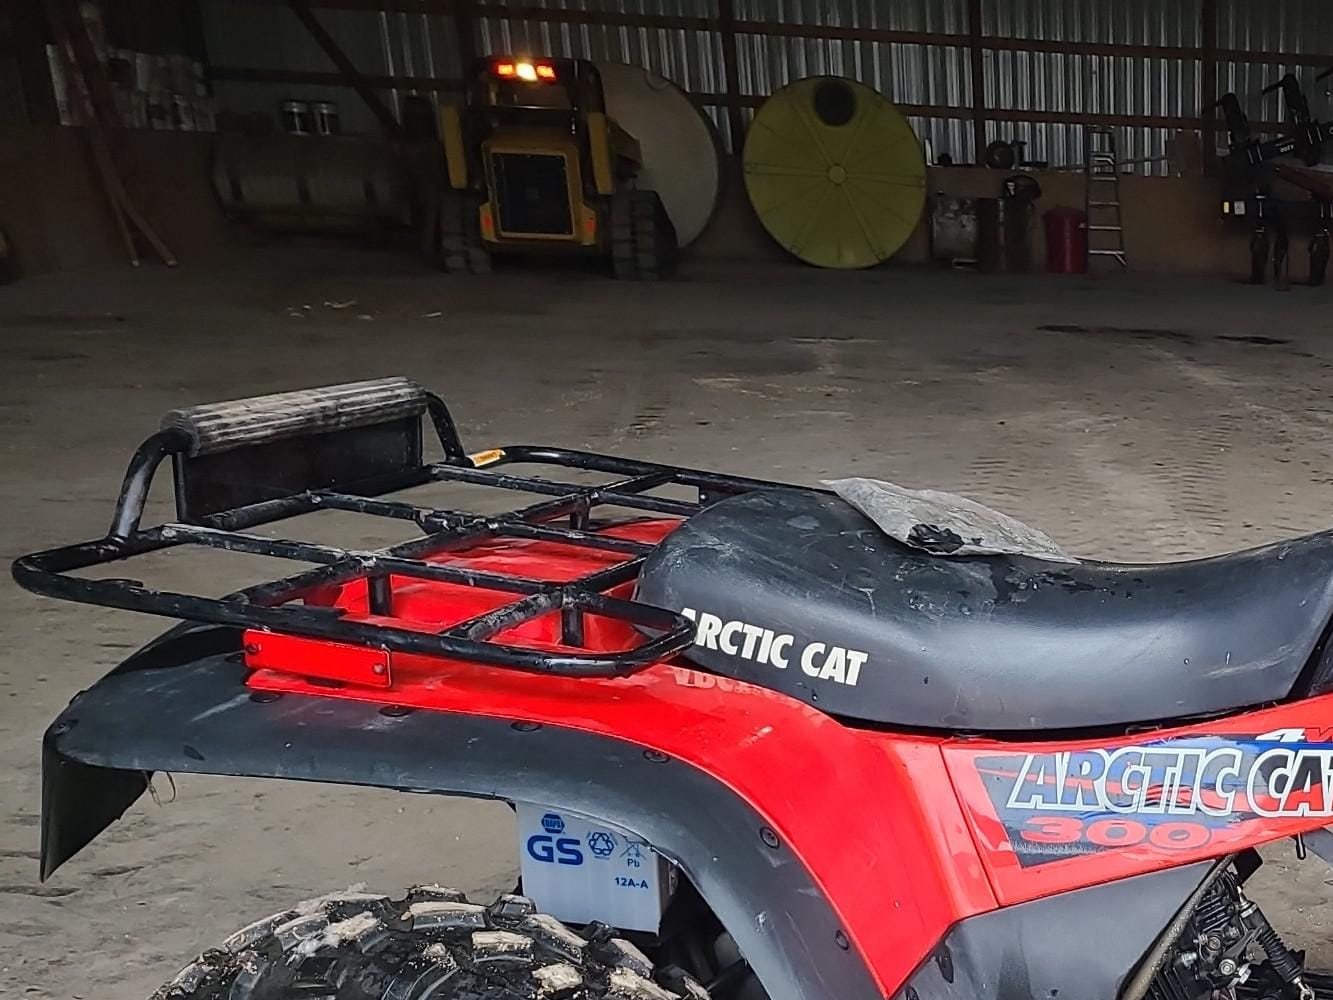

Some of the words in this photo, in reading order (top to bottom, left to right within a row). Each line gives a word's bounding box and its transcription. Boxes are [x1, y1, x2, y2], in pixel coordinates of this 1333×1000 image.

[800, 642, 869, 686] CAT
[1006, 748, 1242, 817] ARCTIC
[1020, 816, 1211, 850] 300
[527, 834, 584, 866] GS
[627, 858, 640, 868] Pb
[614, 877, 649, 889] 12A-A
